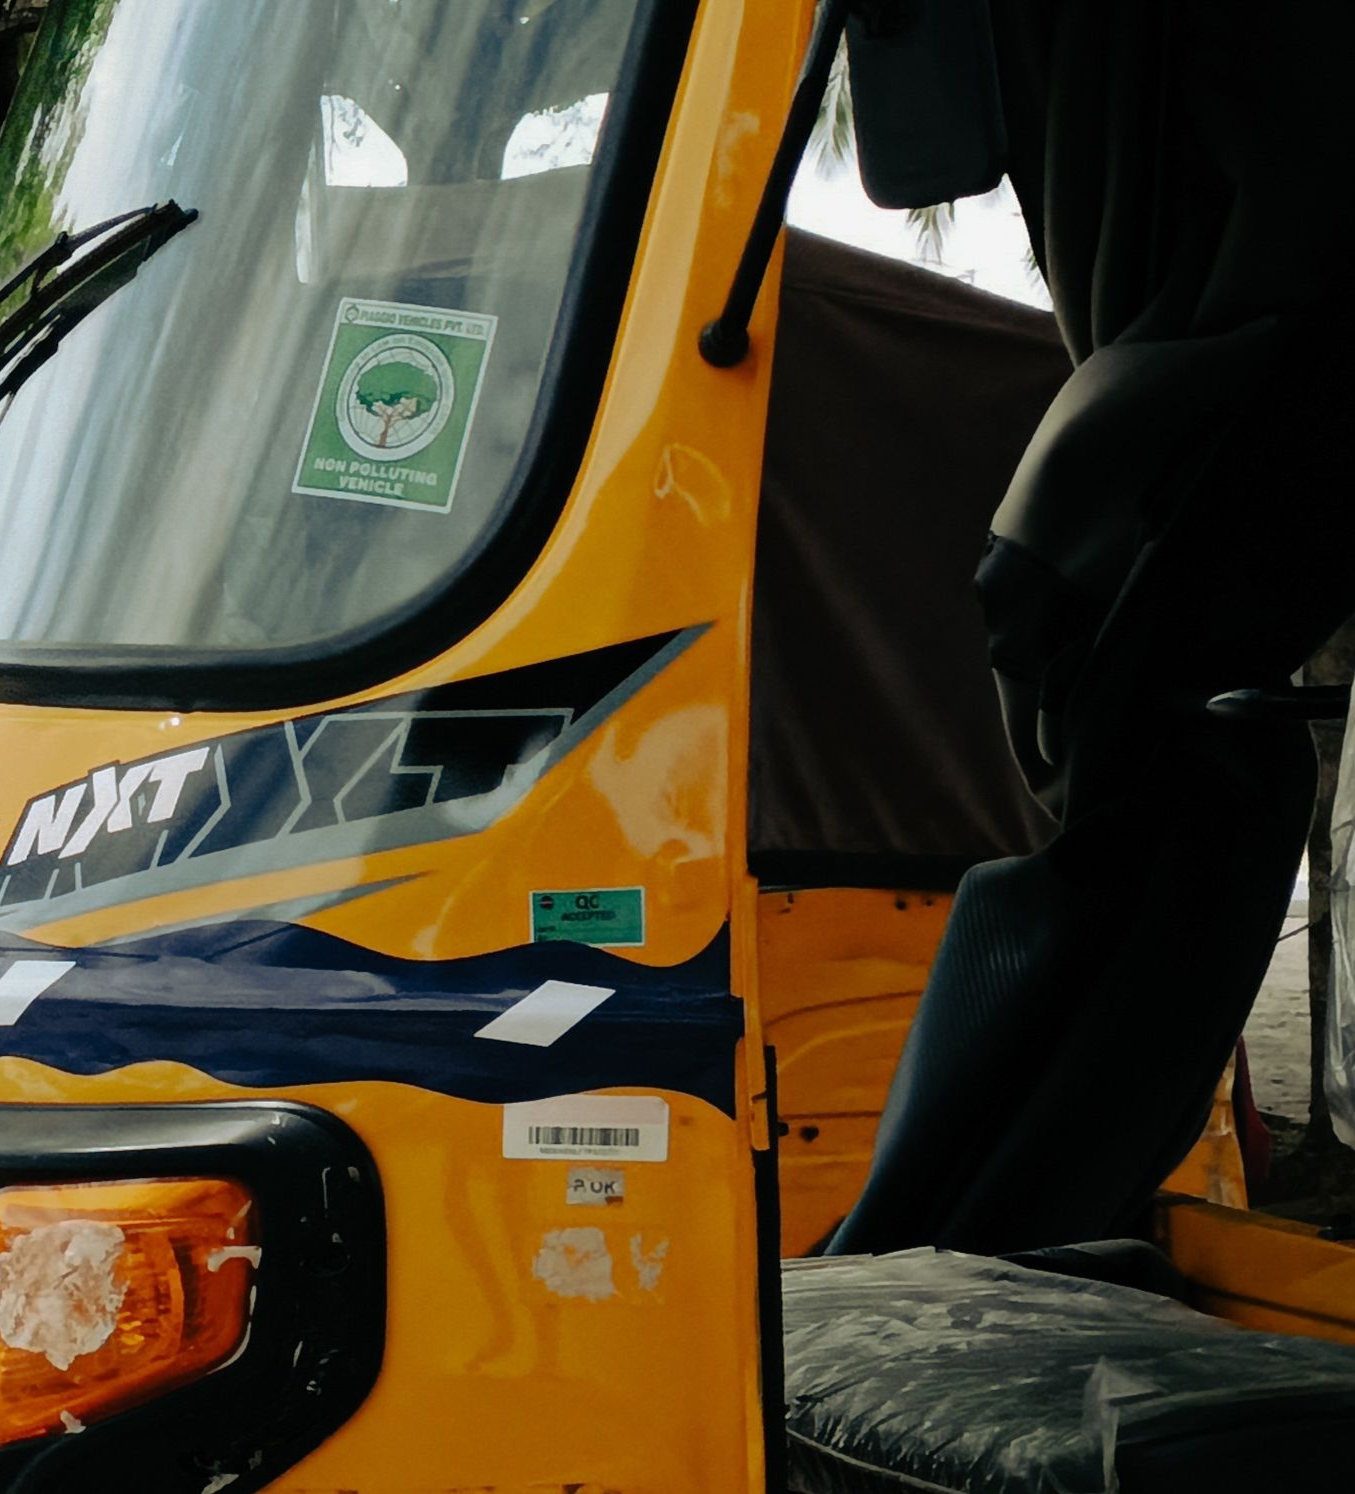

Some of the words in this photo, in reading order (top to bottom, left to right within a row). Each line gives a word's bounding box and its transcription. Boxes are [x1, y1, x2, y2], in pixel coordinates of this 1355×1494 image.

[314, 457, 346, 472] NON
[349, 463, 437, 487] POLLUTING
[339, 475, 405, 495] VEHICLE
[6, 746, 211, 867] NXT
[575, 894, 600, 910] QC
